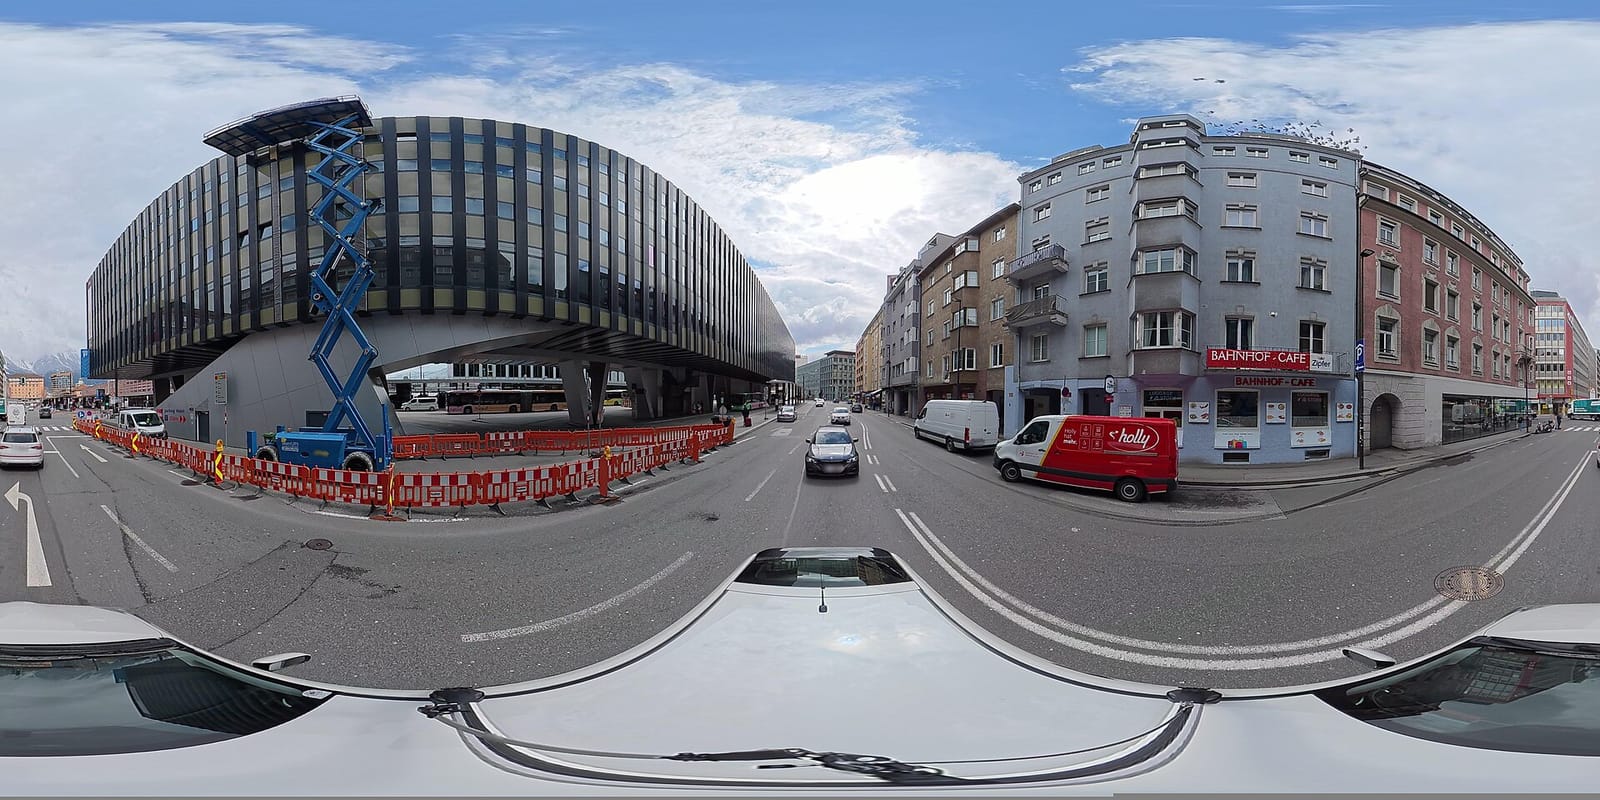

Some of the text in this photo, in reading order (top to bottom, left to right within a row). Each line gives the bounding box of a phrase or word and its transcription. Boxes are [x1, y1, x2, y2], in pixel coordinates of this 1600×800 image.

[1211, 350, 1271, 361] BAHNHOF
[1278, 352, 1306, 364] CAFE
[1312, 358, 1332, 368] Zipfer
[1236, 377, 1285, 387] BAHNHOF
[1290, 378, 1316, 387] CAFE
[1118, 427, 1150, 448] holly
